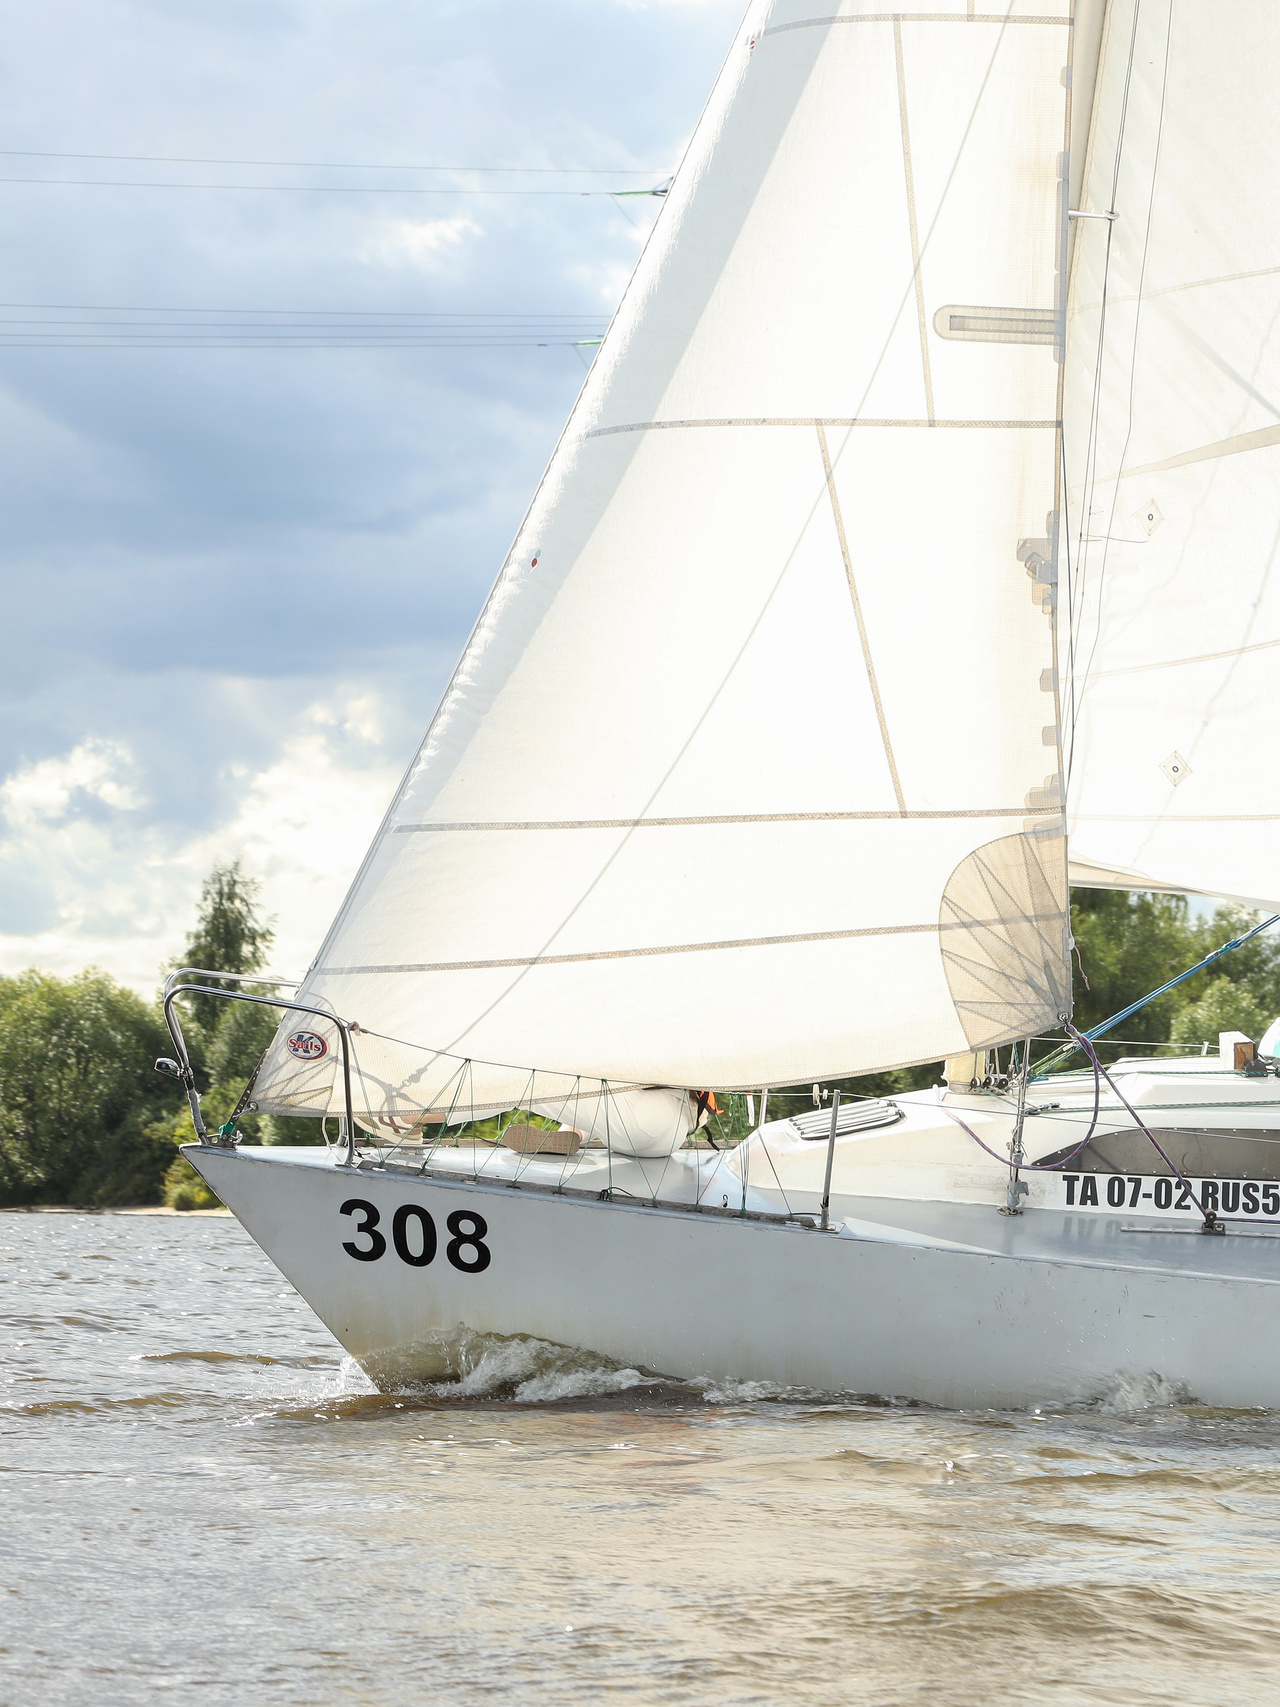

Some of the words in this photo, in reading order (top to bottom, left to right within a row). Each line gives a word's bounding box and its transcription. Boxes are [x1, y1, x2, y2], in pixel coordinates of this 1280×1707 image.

[288, 1038, 321, 1052] Sails
[1062, 1174, 1099, 1206] TA
[1107, 1176, 1192, 1211] 07-02
[339, 1198, 491, 1274] 308
